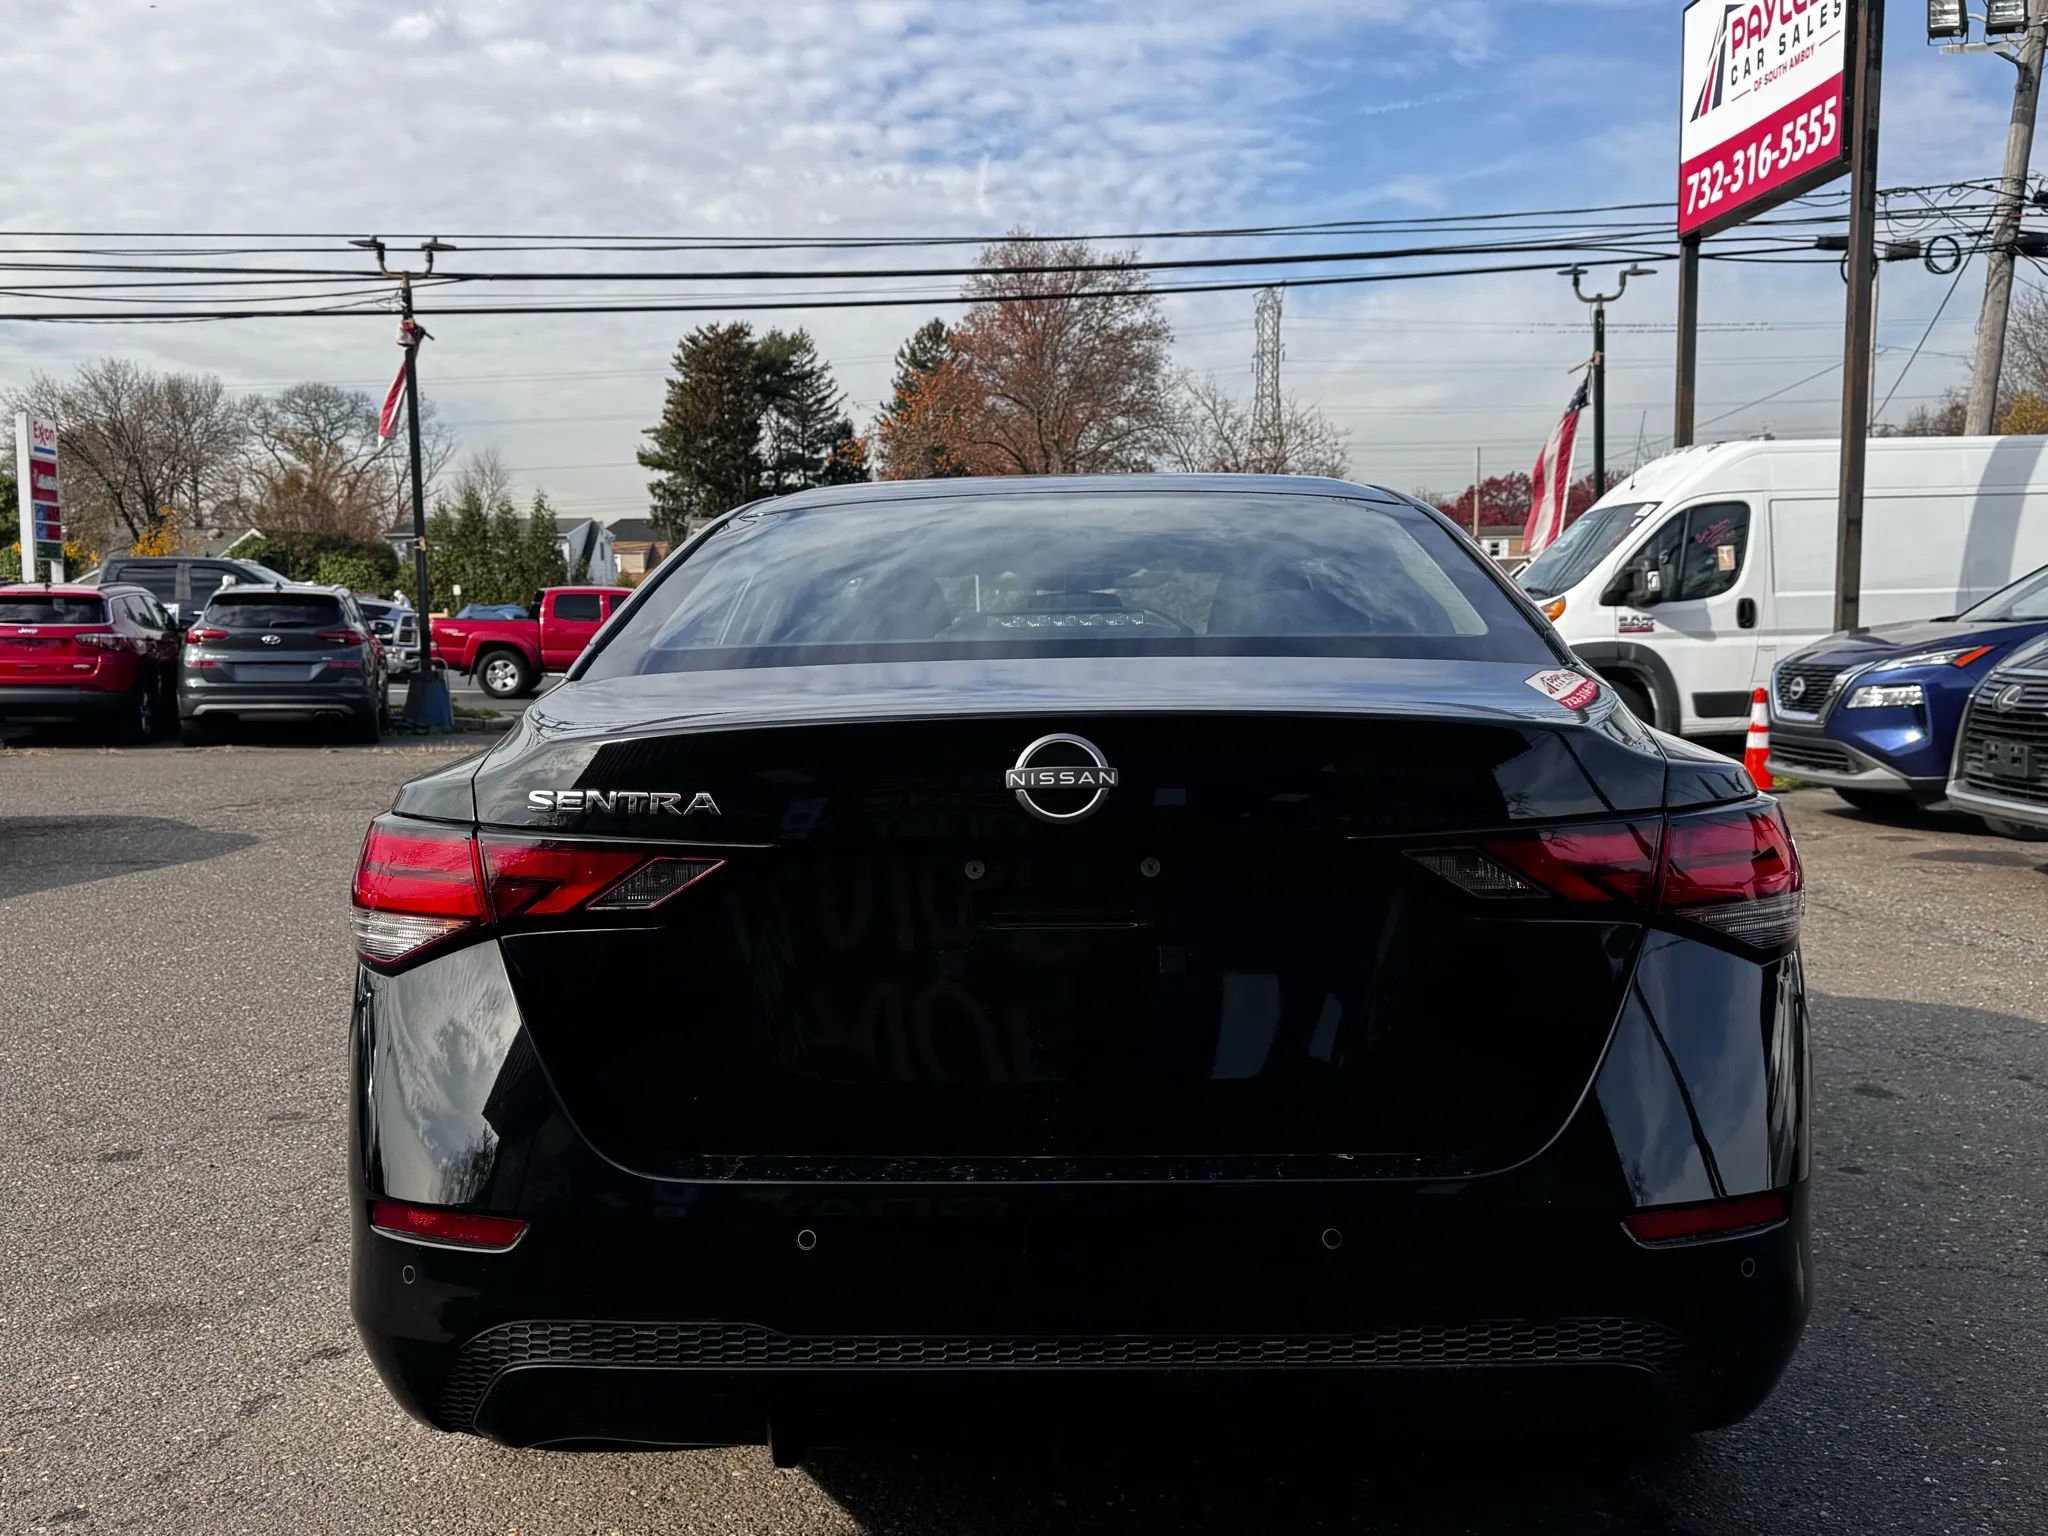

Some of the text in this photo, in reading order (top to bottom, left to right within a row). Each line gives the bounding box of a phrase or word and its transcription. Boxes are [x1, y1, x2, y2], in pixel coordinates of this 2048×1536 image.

[1731, 0, 1842, 86] CAR SALES
[1732, 0, 1820, 60] PAYL
[1753, 43, 1816, 92] OF SOUTH AMBOY
[1687, 96, 1837, 215] 732-316-5555
[527, 789, 722, 816] SENTRA
[1009, 771, 1116, 786] NISSAN
